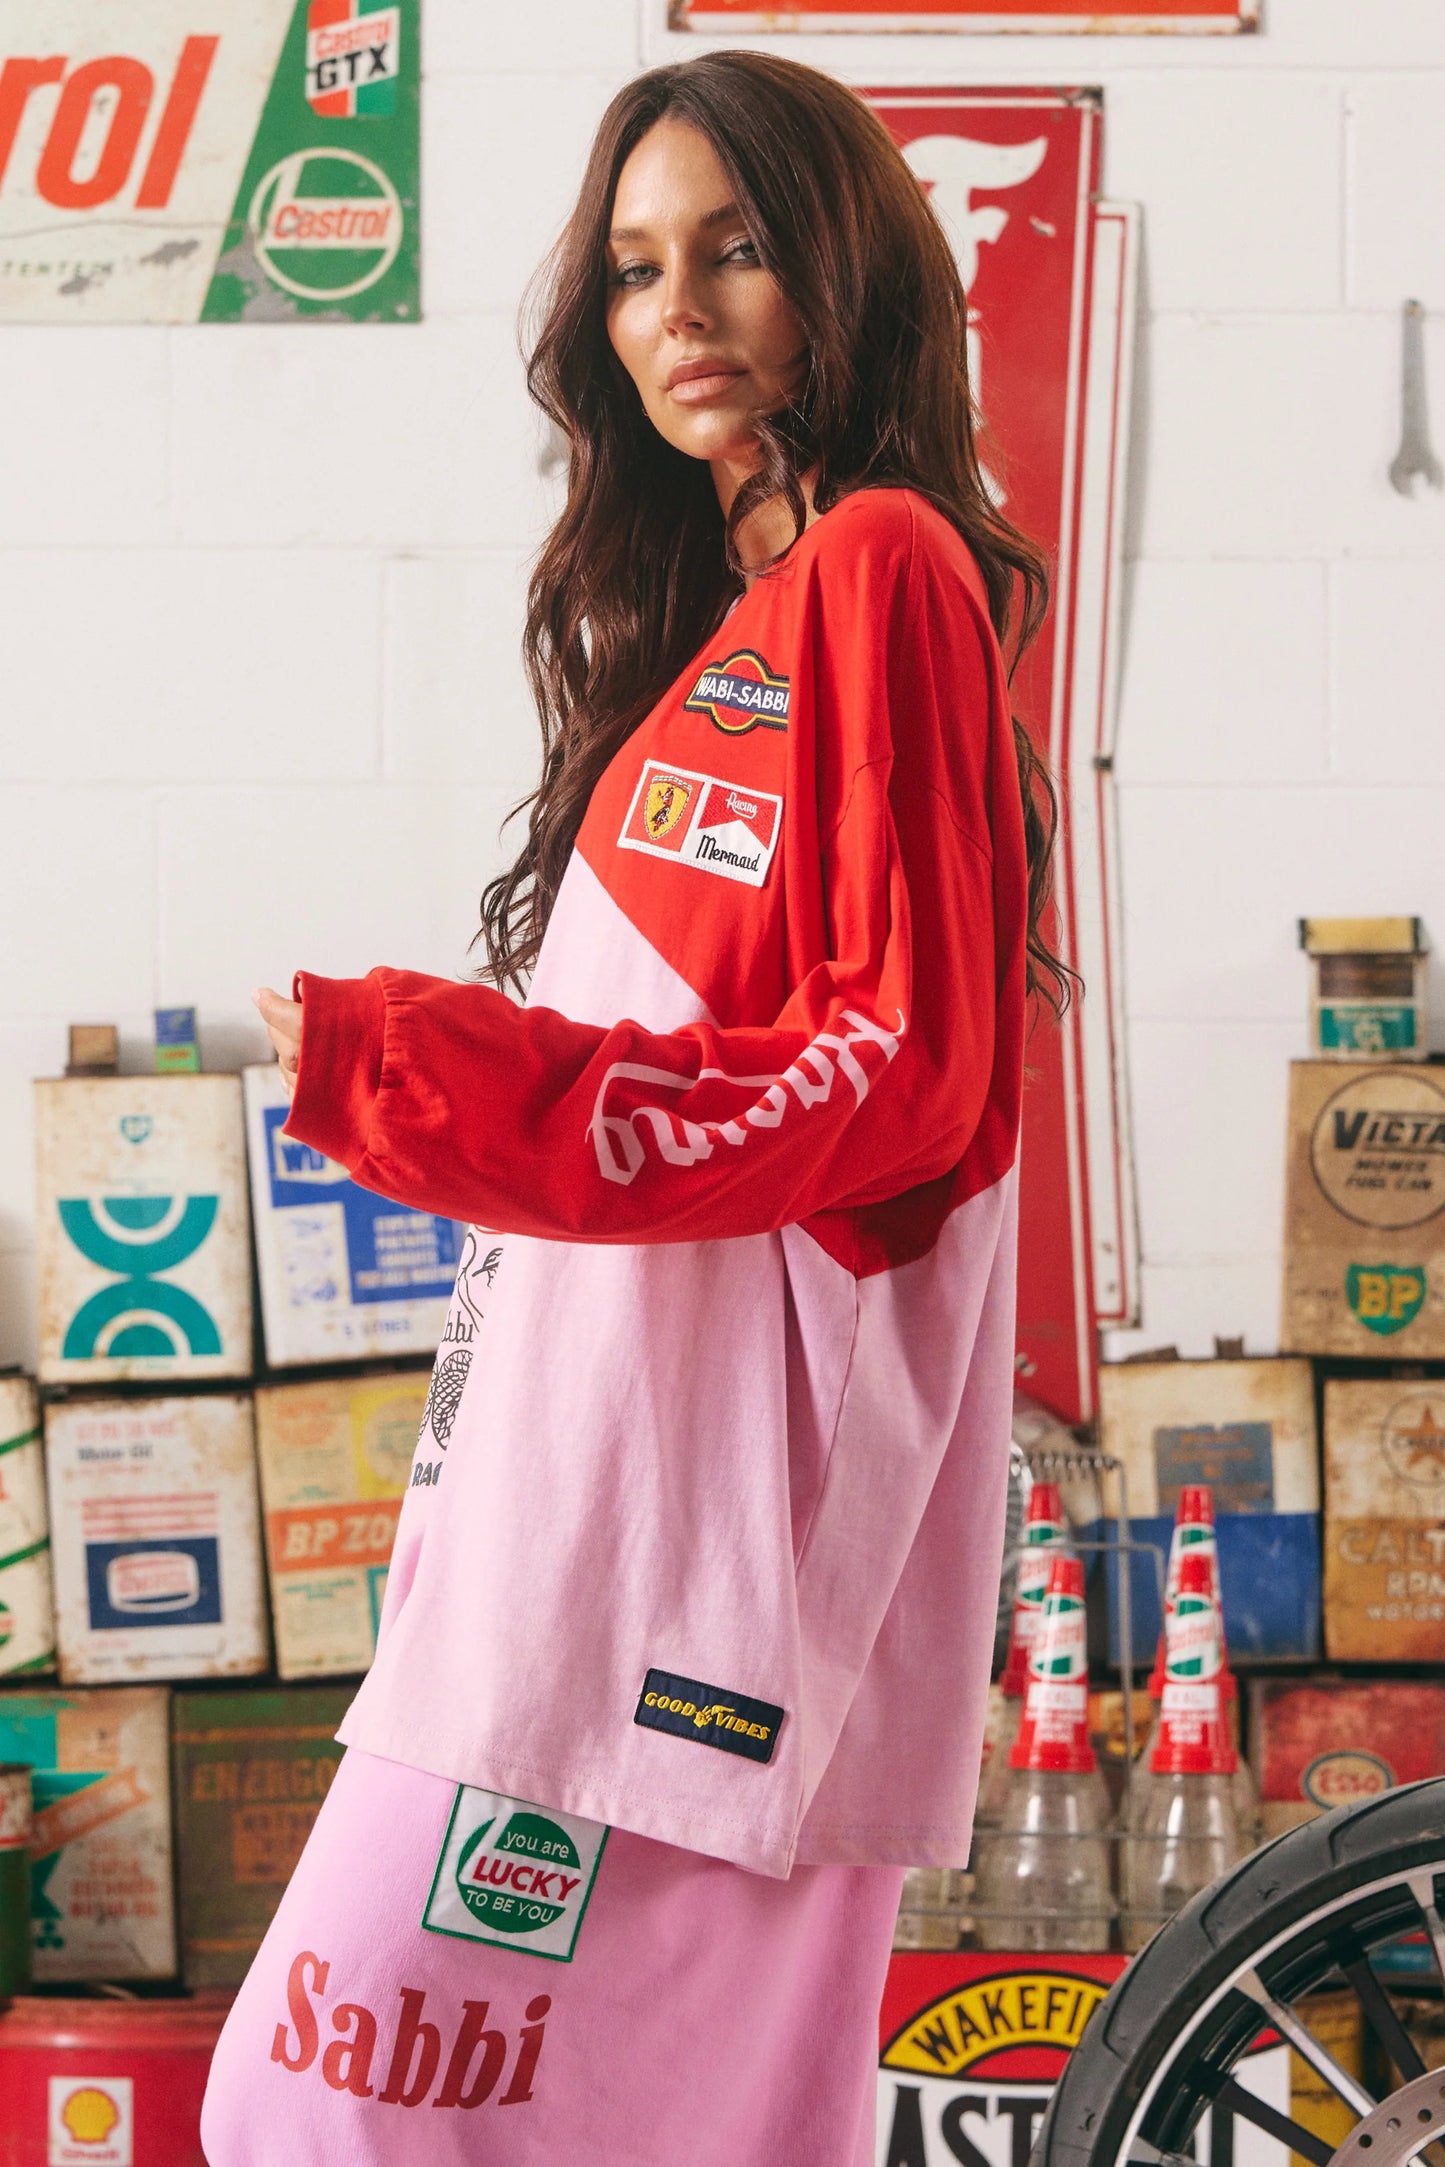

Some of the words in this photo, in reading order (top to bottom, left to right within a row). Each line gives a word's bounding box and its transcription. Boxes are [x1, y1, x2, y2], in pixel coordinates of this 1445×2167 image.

[315, 43, 388, 91] GTX
[273, 205, 393, 240] Castrol
[695, 676, 789, 713] WABI-SABBI
[725, 791, 758, 819] Racing
[696, 834, 761, 872] Mermaid
[1334, 1111, 1445, 1149] VICTA
[1358, 1273, 1421, 1319] BP
[283, 1519, 338, 1559] BP
[341, 1513, 398, 1552] ZO
[644, 1692, 697, 1717] GOOD
[715, 1712, 771, 1741] VIBES
[503, 1831, 538, 1849] you
[540, 1839, 569, 1859] are
[472, 1856, 581, 1902] LUCKY
[466, 1890, 488, 1907] TO
[492, 1896, 515, 1914] BE
[517, 1902, 554, 1923] YOU
[270, 1951, 552, 2110] Sabbi
